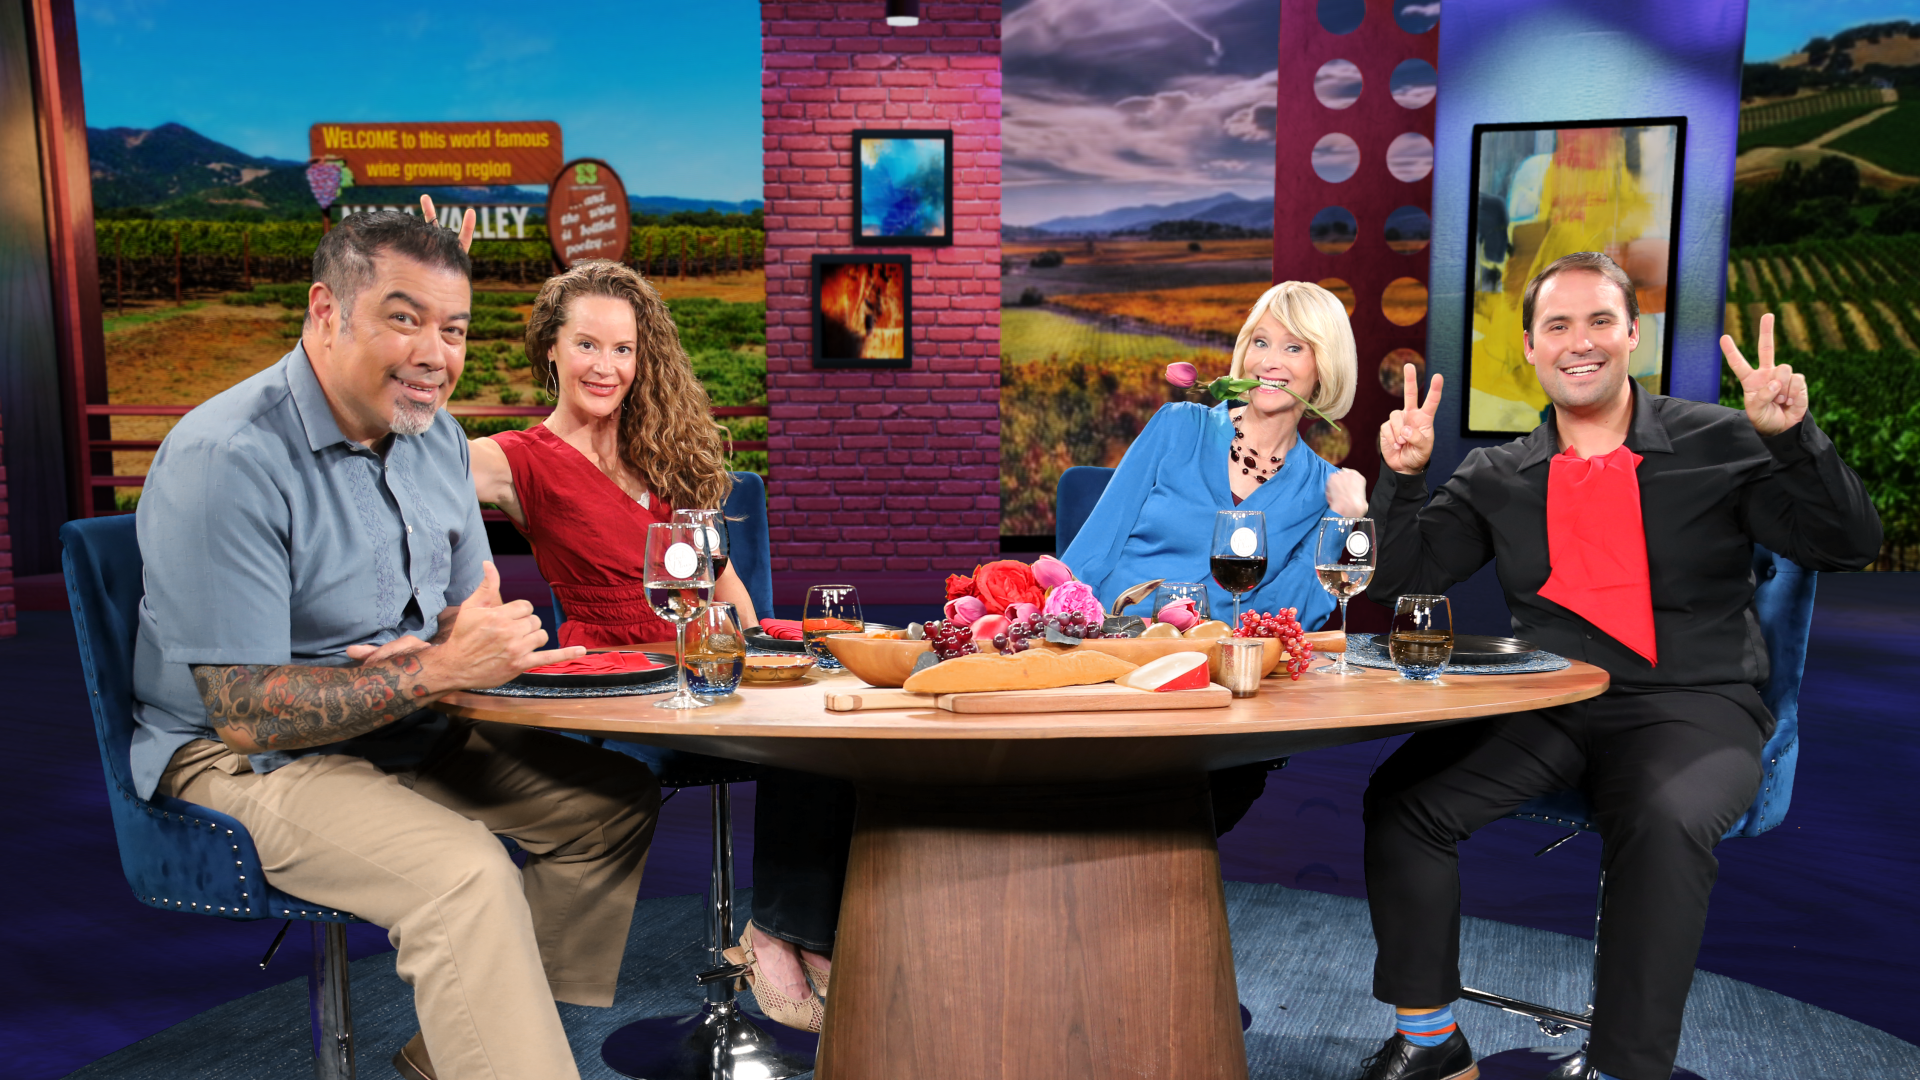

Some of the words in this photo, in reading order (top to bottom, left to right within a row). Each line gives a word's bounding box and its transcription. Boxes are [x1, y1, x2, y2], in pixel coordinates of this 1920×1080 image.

[401, 131, 416, 149] to
[420, 130, 447, 149] this
[450, 129, 491, 148] world
[495, 128, 550, 148] famous
[366, 161, 401, 177] wine
[404, 161, 462, 181] growing
[466, 160, 512, 181] region
[561, 212, 580, 226] the
[588, 204, 616, 218] wine
[580, 216, 616, 237] bottled
